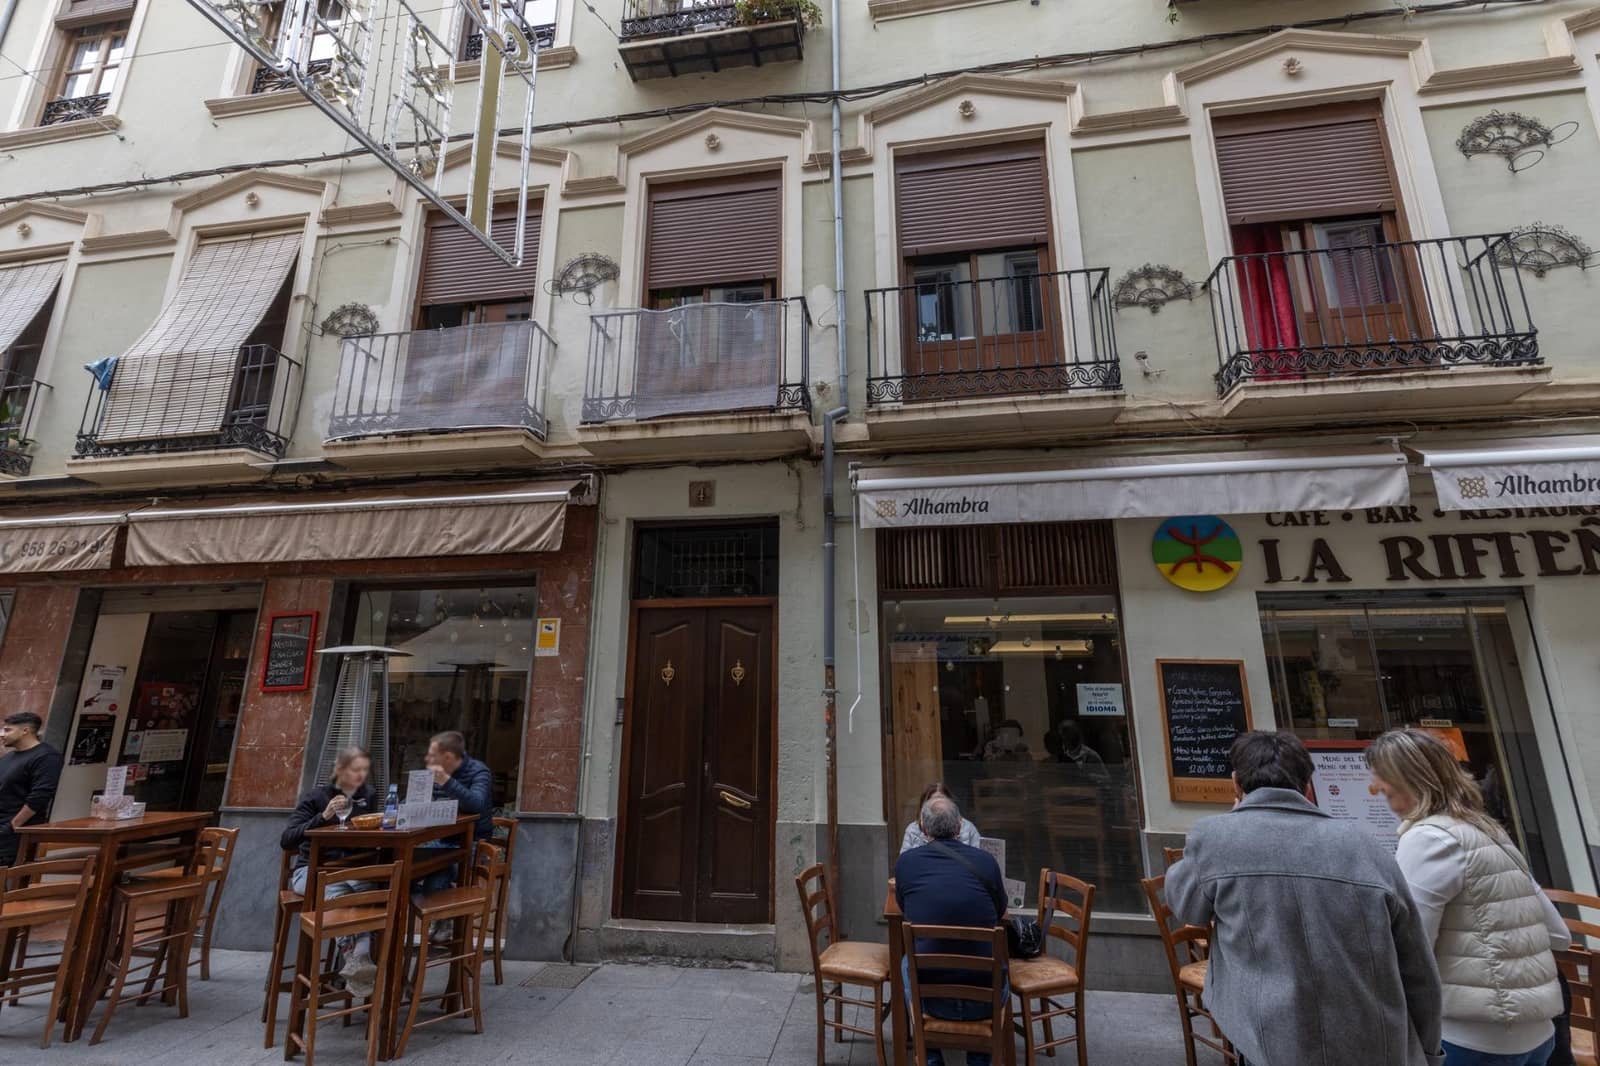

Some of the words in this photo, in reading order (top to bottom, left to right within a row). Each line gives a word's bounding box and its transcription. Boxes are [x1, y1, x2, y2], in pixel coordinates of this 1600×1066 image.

[902, 496, 989, 518] Alhambra
[1366, 506, 1422, 524] BAR
[21, 542, 45, 557] 958
[48, 541, 66, 555] 26
[1258, 538, 1352, 583] LA
